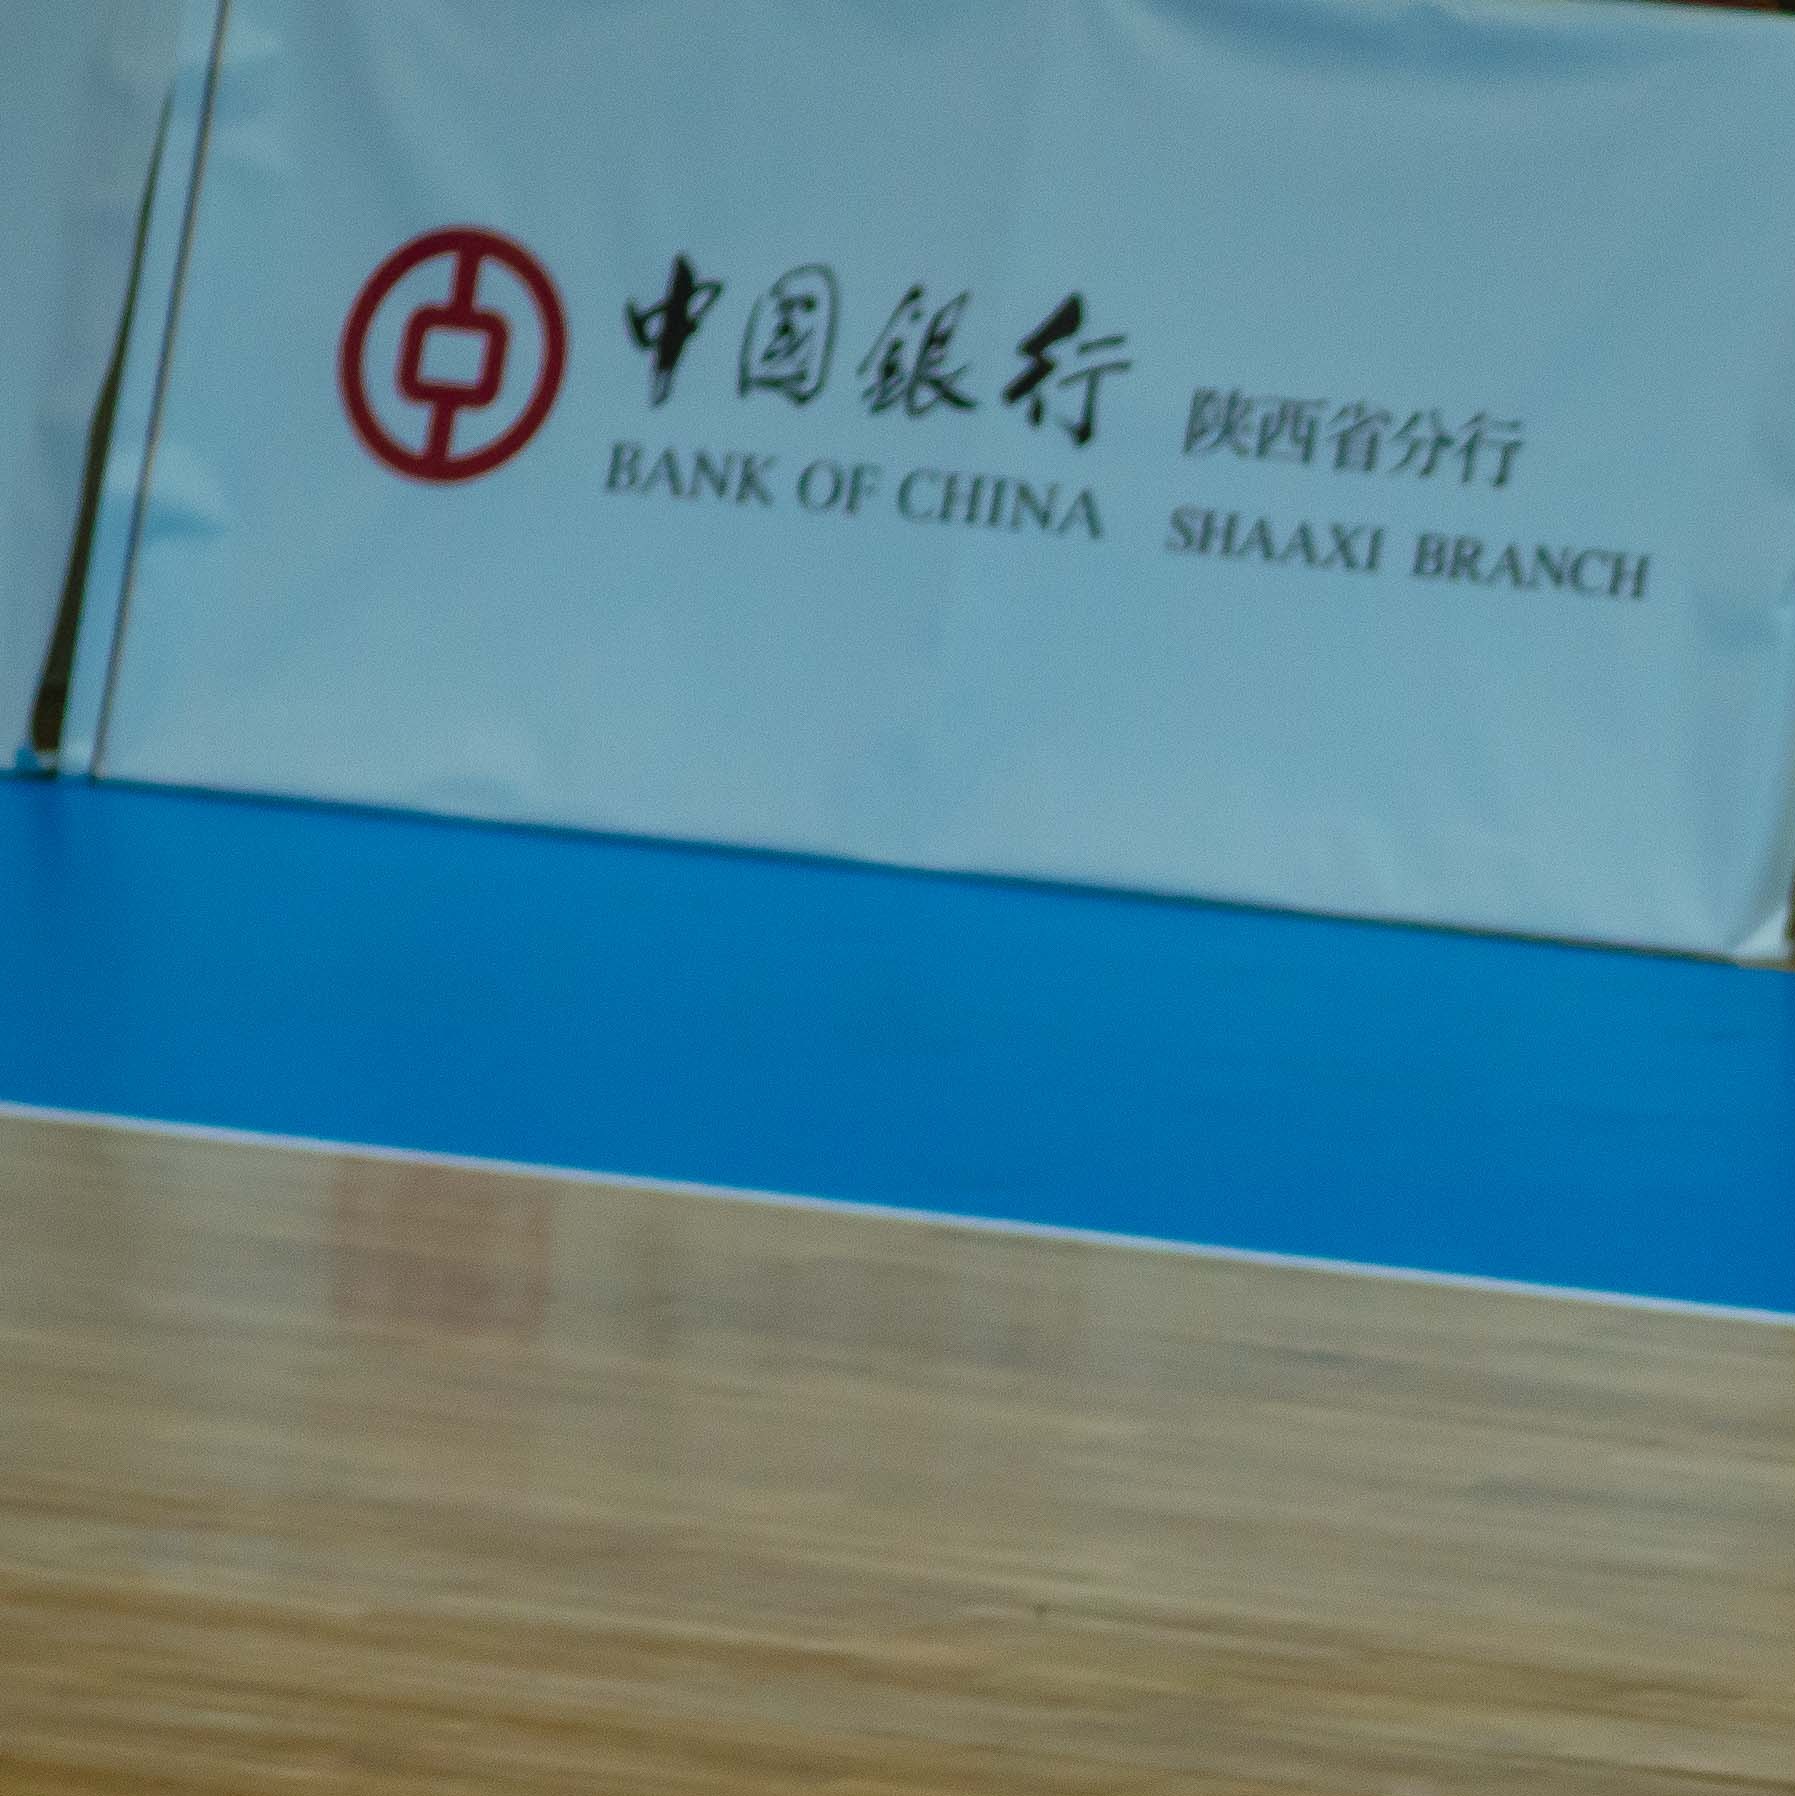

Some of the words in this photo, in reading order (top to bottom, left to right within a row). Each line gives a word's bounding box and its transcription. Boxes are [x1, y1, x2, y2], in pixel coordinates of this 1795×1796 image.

[1182, 387, 1524, 488] 陕西省分行
[605, 440, 778, 506] BANK
[797, 457, 881, 518] OF
[896, 467, 1106, 541] CHINA
[1166, 504, 1386, 572] SHAAXI
[1411, 530, 1652, 602] BRANCH
